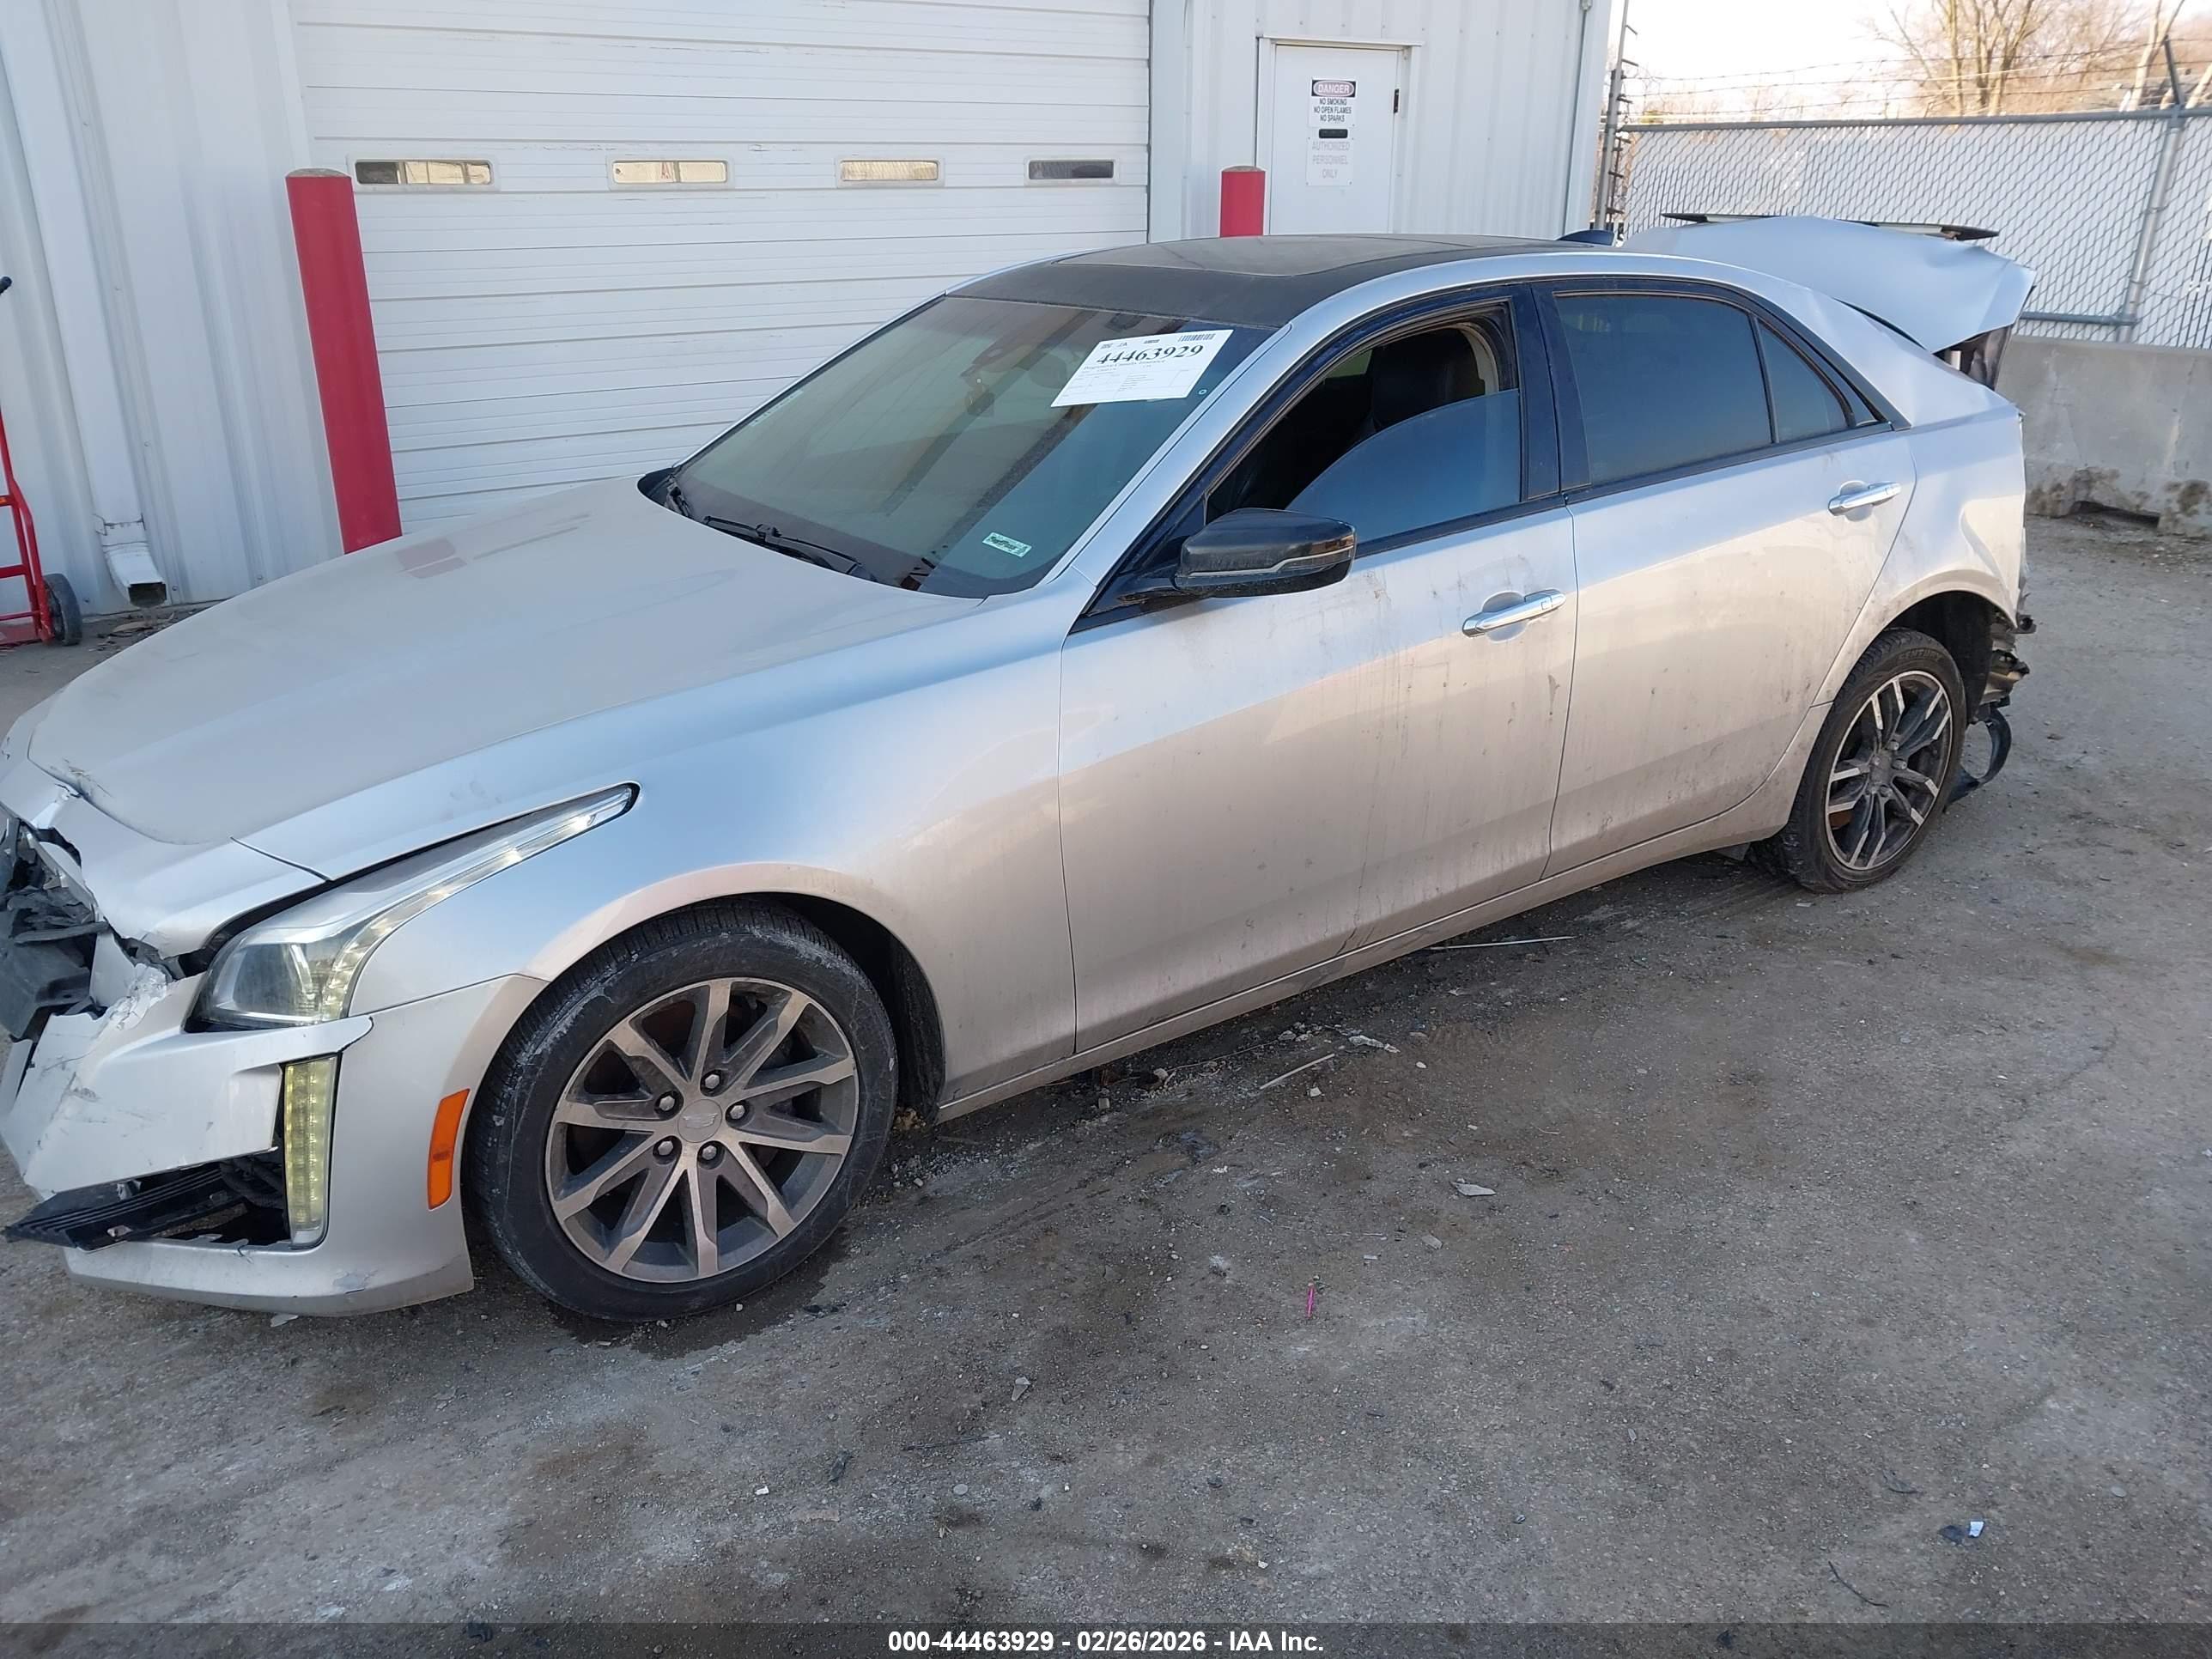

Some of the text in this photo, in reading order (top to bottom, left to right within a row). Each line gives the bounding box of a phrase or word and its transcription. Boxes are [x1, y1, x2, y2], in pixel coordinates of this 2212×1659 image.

[1317, 83, 1350, 94] DANGER
[1322, 106, 1334, 114] OPEN
[1328, 114, 1346, 123] SPARKS
[1322, 168, 1339, 179] ONLY
[1097, 344, 1204, 364] 44463929
